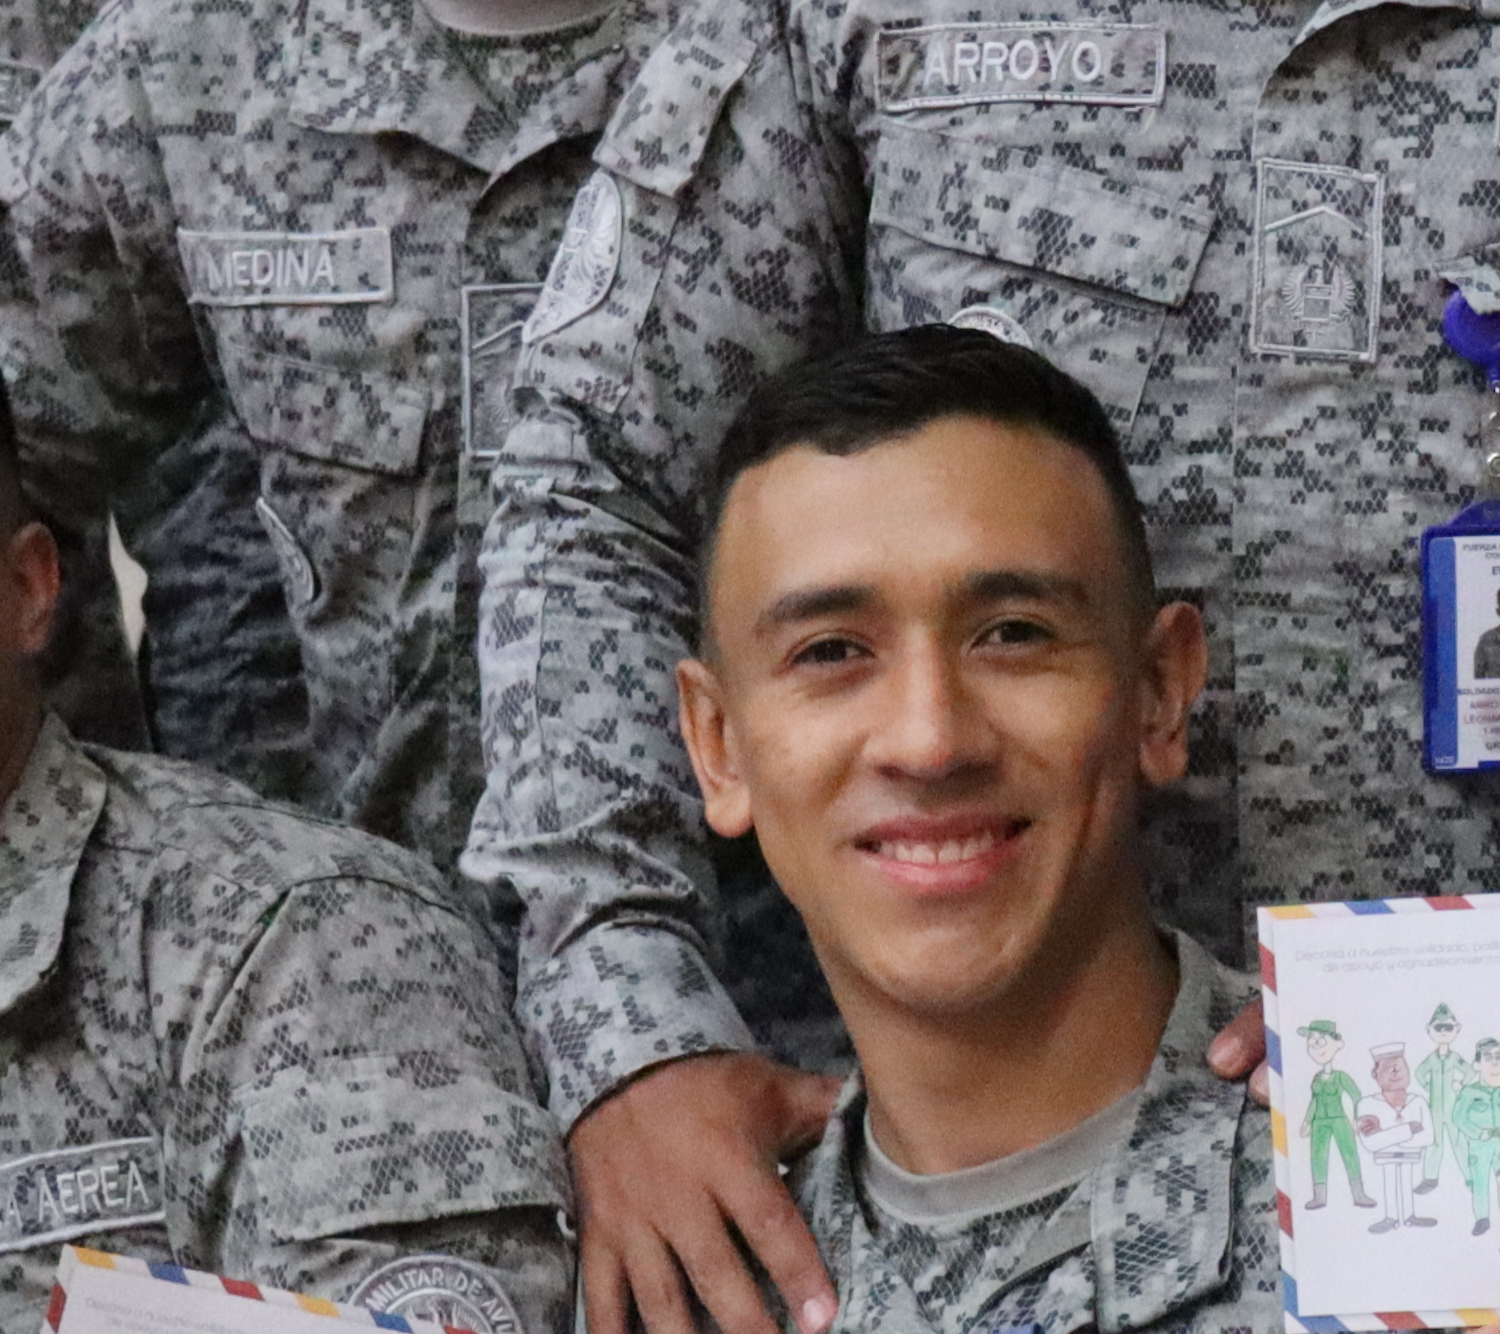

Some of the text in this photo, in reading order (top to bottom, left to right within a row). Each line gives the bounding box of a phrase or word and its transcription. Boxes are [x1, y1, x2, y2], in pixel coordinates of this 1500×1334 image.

[923, 34, 1101, 86] ARROYO
[206, 249, 336, 289] MEDINA
[38, 1160, 150, 1223] AEREA
[364, 1266, 445, 1312] MILITAR
[454, 1271, 484, 1299] DE
